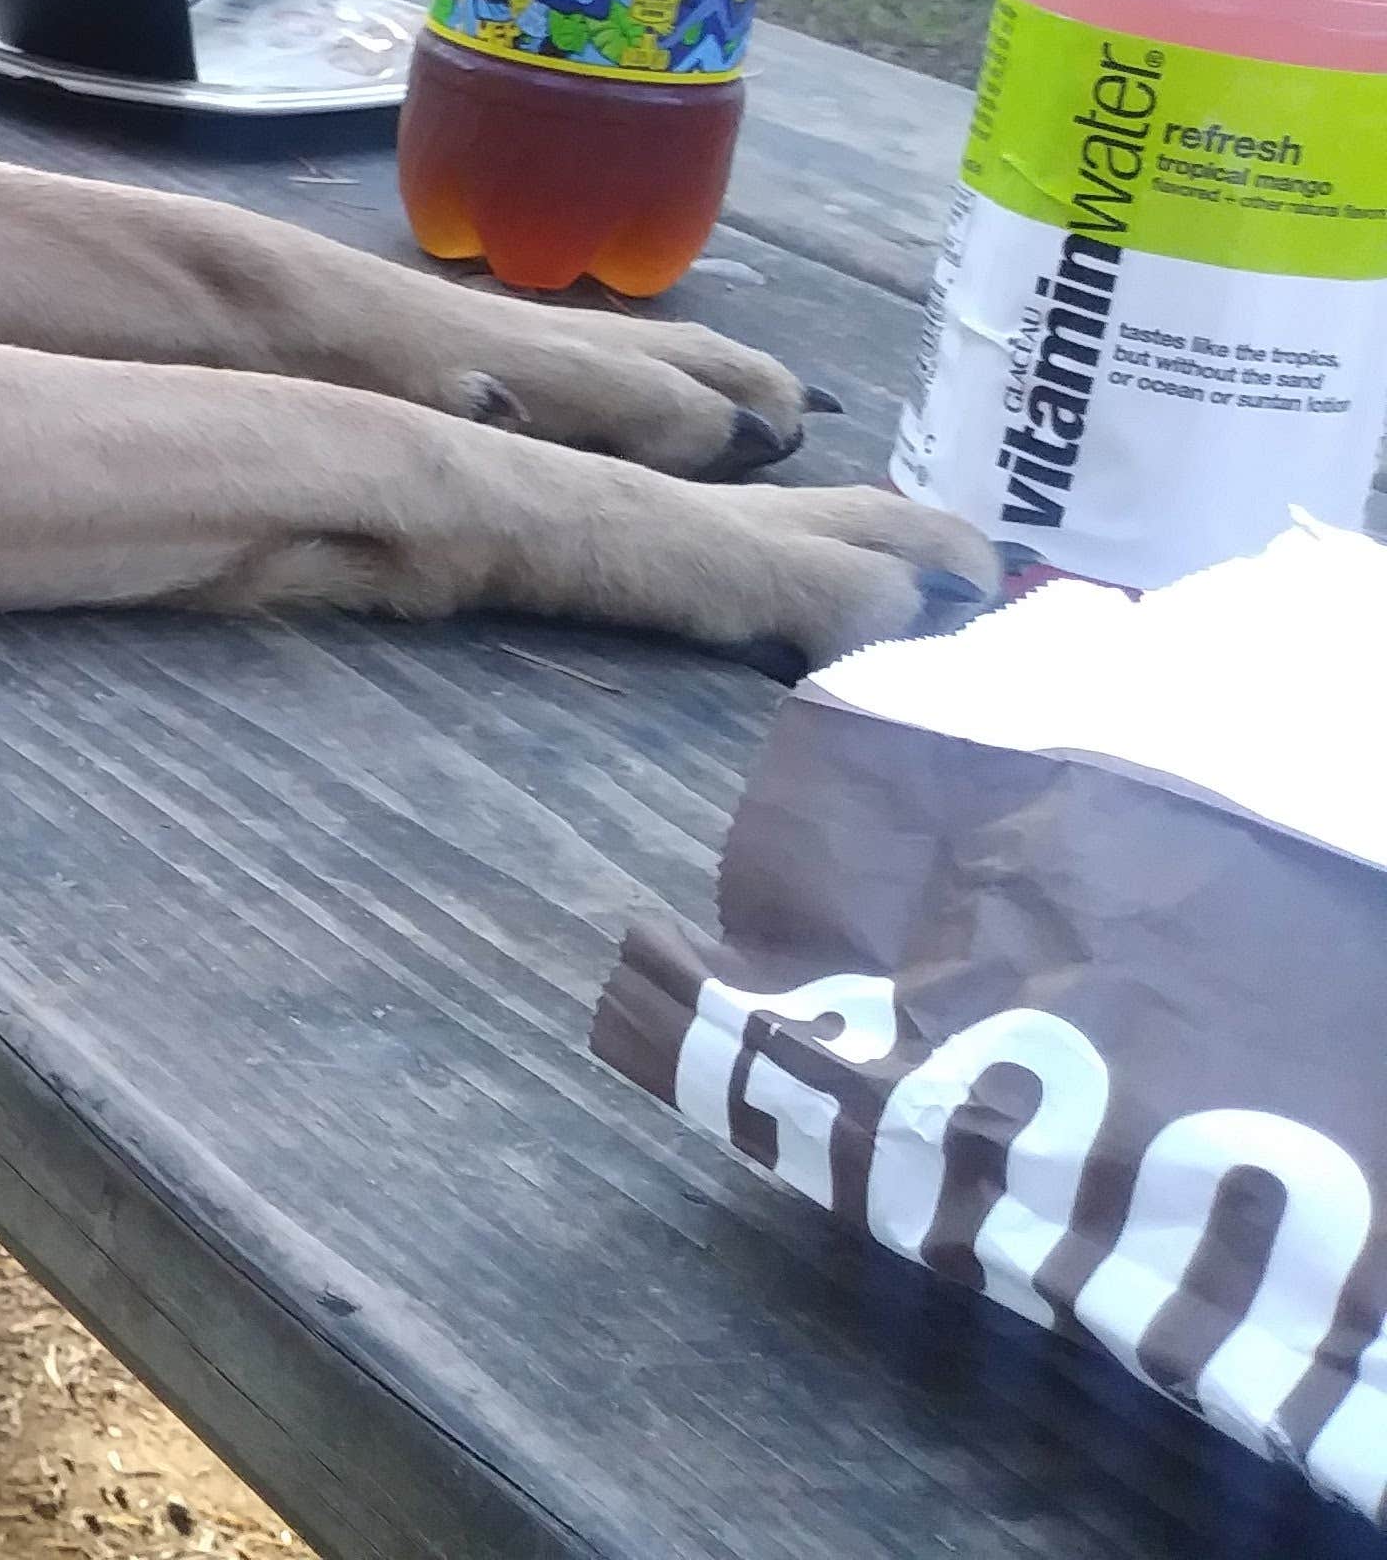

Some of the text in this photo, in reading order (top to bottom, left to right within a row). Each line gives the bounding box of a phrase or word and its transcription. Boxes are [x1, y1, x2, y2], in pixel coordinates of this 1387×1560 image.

[1163, 122, 1303, 165] refresh
[1156, 153, 1251, 187] tropical
[1120, 322, 1187, 351] tastes
[1235, 344, 1268, 362] the
[1113, 344, 1152, 368] but
[1154, 355, 1237, 384] without
[1240, 368, 1273, 386] the
[1108, 370, 1134, 387] or
[1136, 376, 1205, 403] ocean
[1209, 390, 1235, 406] or
